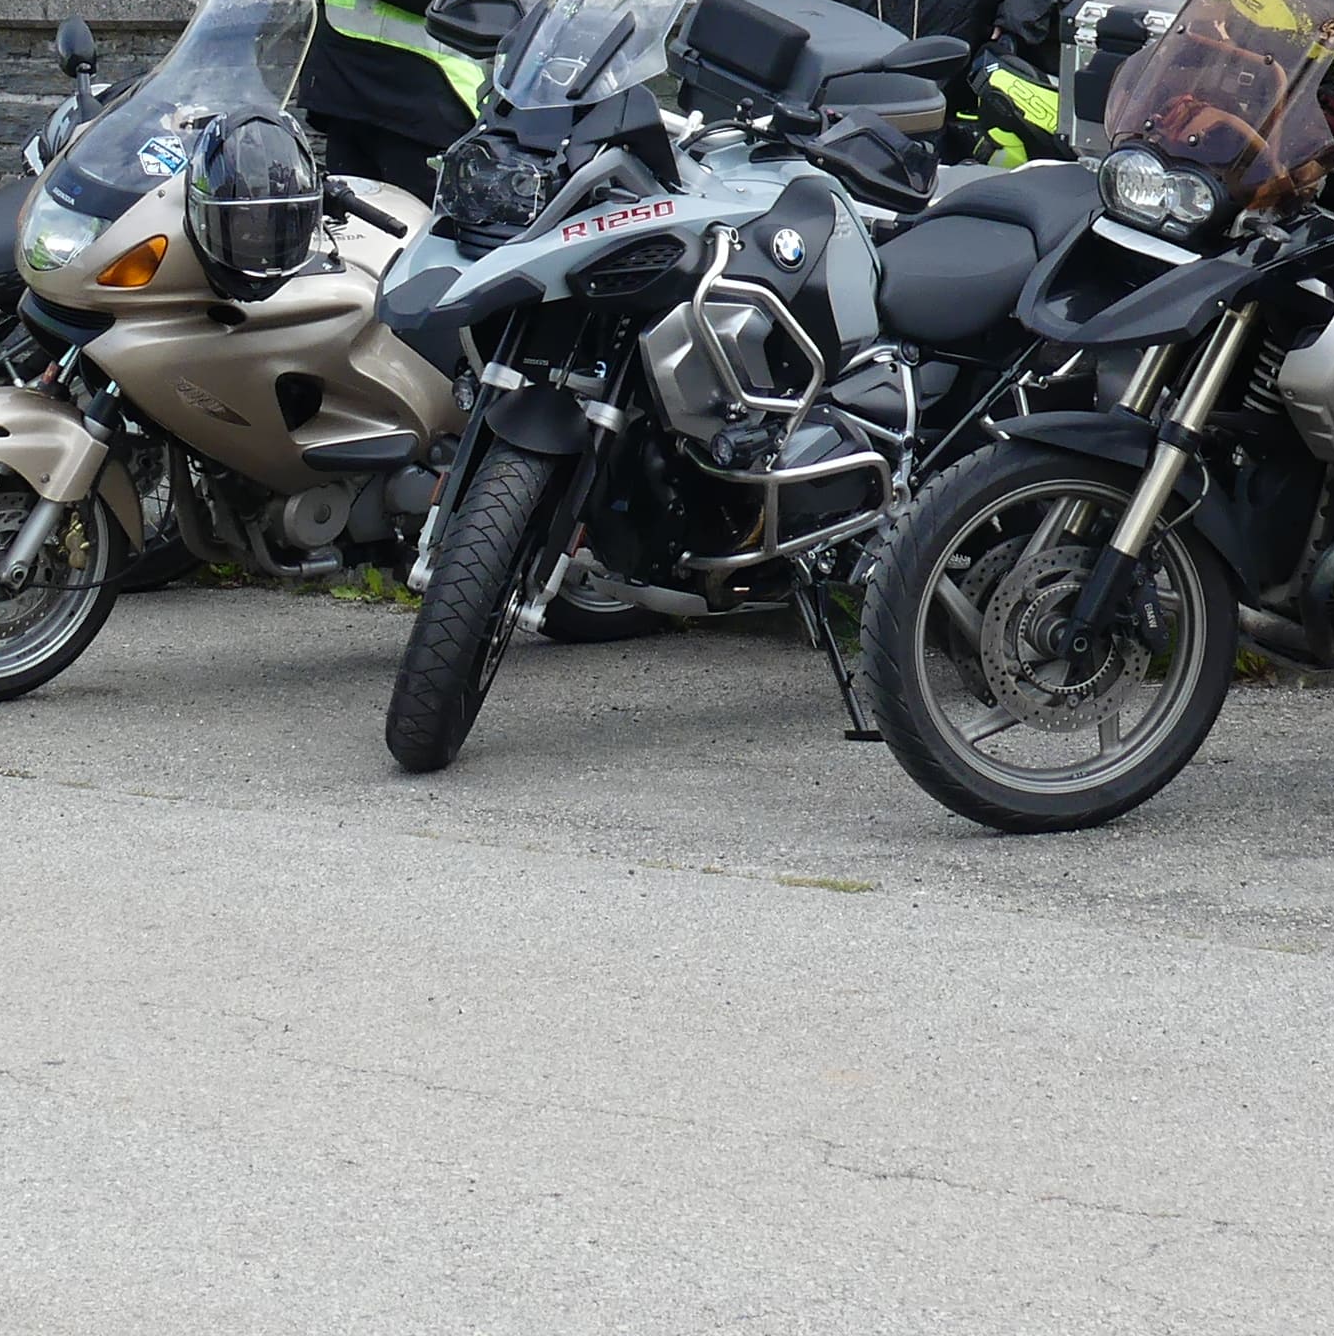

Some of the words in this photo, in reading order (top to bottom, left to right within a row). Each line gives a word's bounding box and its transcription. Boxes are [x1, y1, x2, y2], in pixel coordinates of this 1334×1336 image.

[562, 221, 587, 242] R
[591, 200, 674, 233] 1250
[1144, 602, 1158, 628] BMW
